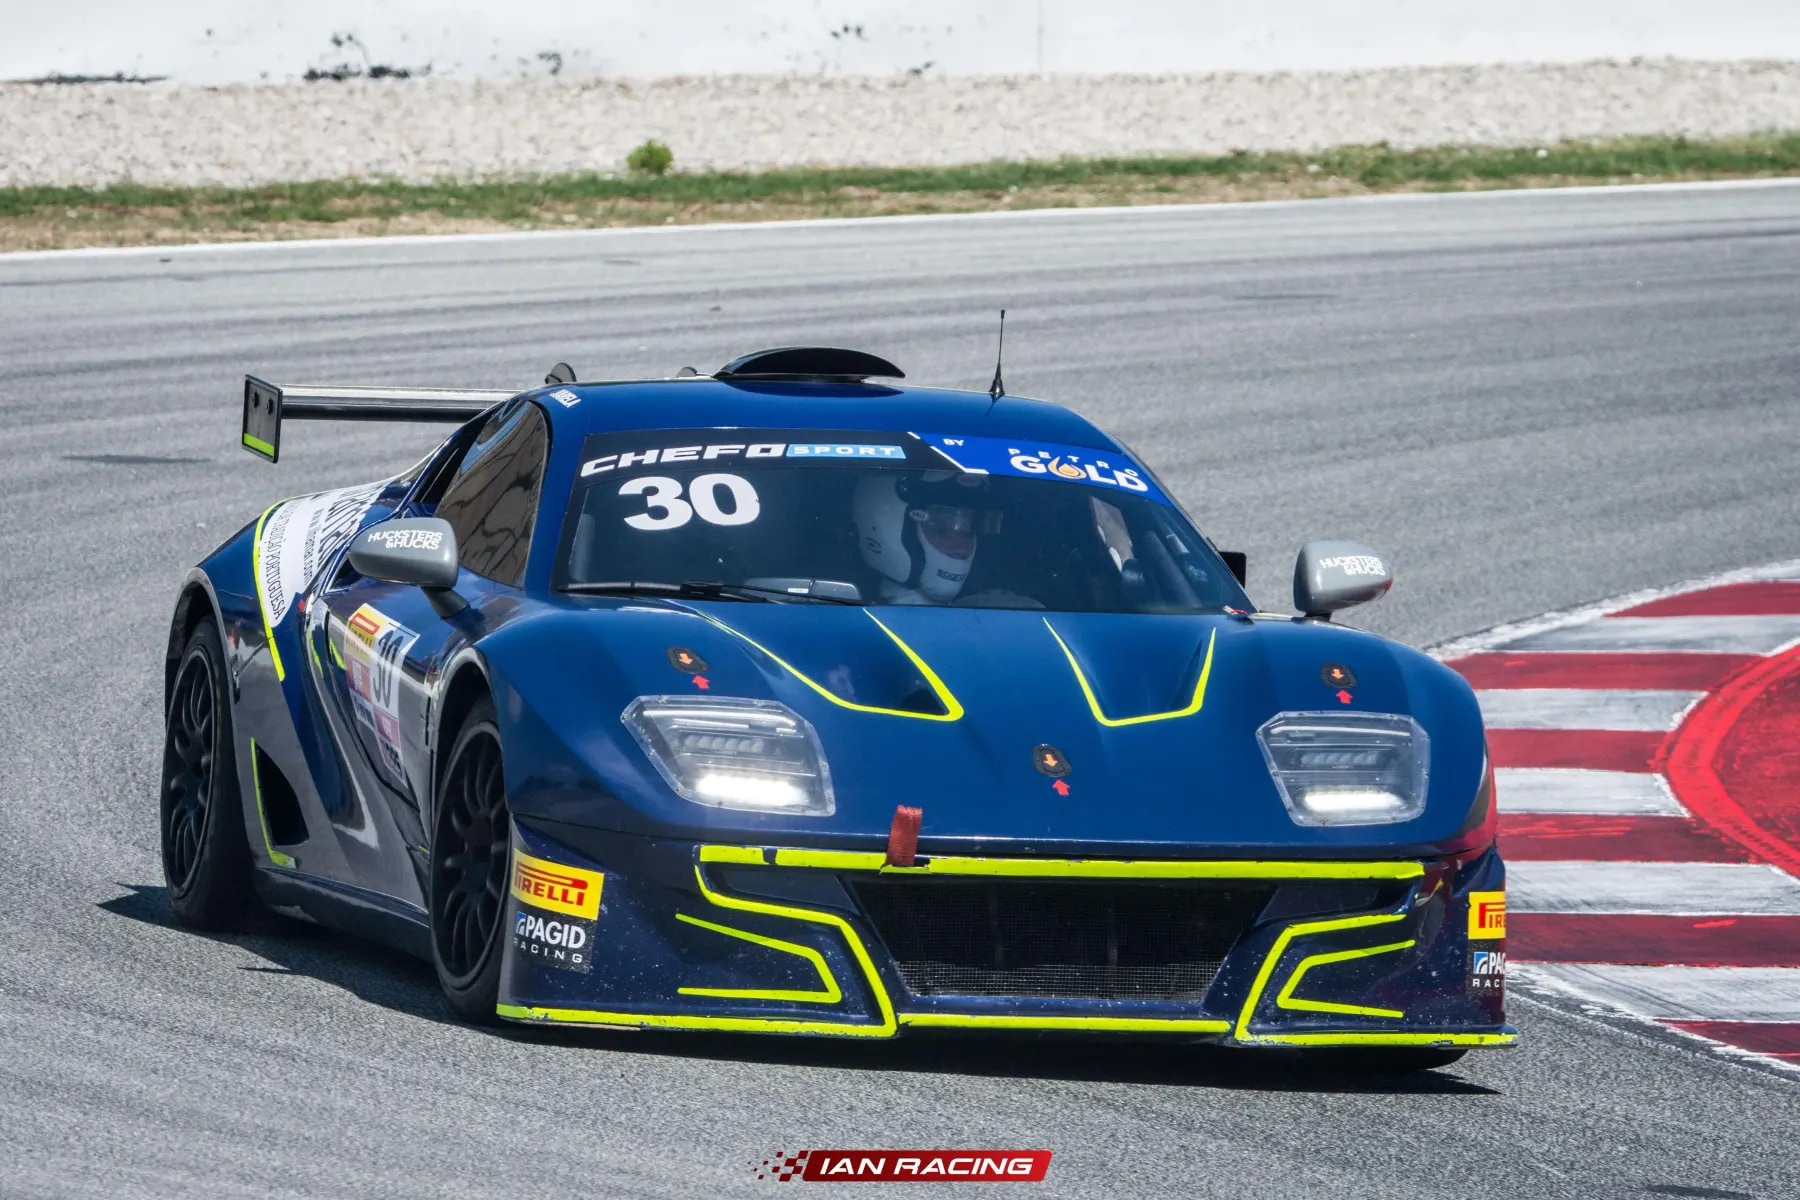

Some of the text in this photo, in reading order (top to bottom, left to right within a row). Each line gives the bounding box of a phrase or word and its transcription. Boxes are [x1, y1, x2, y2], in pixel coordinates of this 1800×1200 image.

[943, 438, 965, 447] BY
[580, 443, 897, 477] CHEFO SPORT
[1008, 448, 1139, 477] PETRO
[1010, 455, 1149, 492] GOLD
[618, 473, 761, 531] 30
[367, 530, 444, 543] HUCKSTERS
[266, 552, 286, 621] PORTUGUESA
[514, 860, 588, 906] PIRELLI
[525, 914, 586, 949] PAGID
[1478, 902, 1506, 928] PIR
[513, 937, 583, 964] RACING
